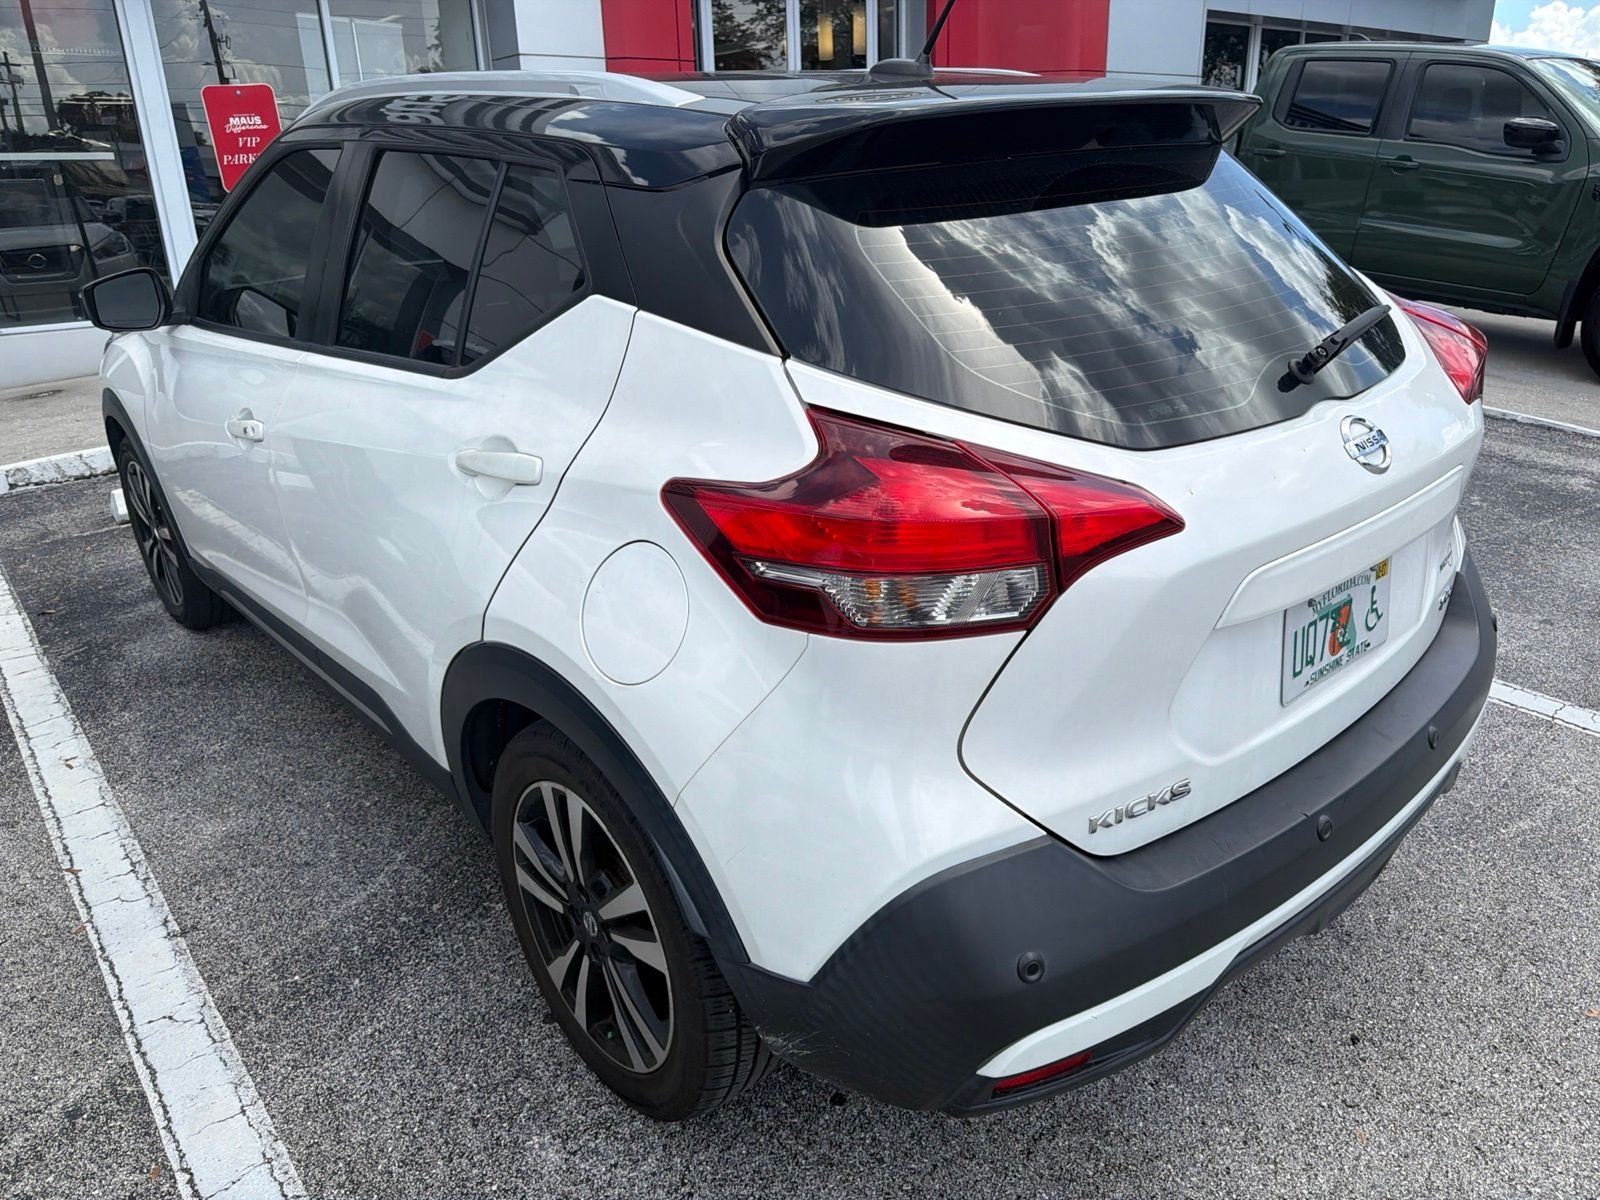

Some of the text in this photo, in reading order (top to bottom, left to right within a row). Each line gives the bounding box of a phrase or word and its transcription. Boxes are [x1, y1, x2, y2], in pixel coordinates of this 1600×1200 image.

[229, 116, 262, 125] MAUS
[224, 123, 269, 133] Difference
[238, 136, 260, 148] VIP
[223, 153, 260, 165] PARK
[1310, 639, 1368, 685] SUNSHINE STATE
[1088, 777, 1192, 835] KICKS
